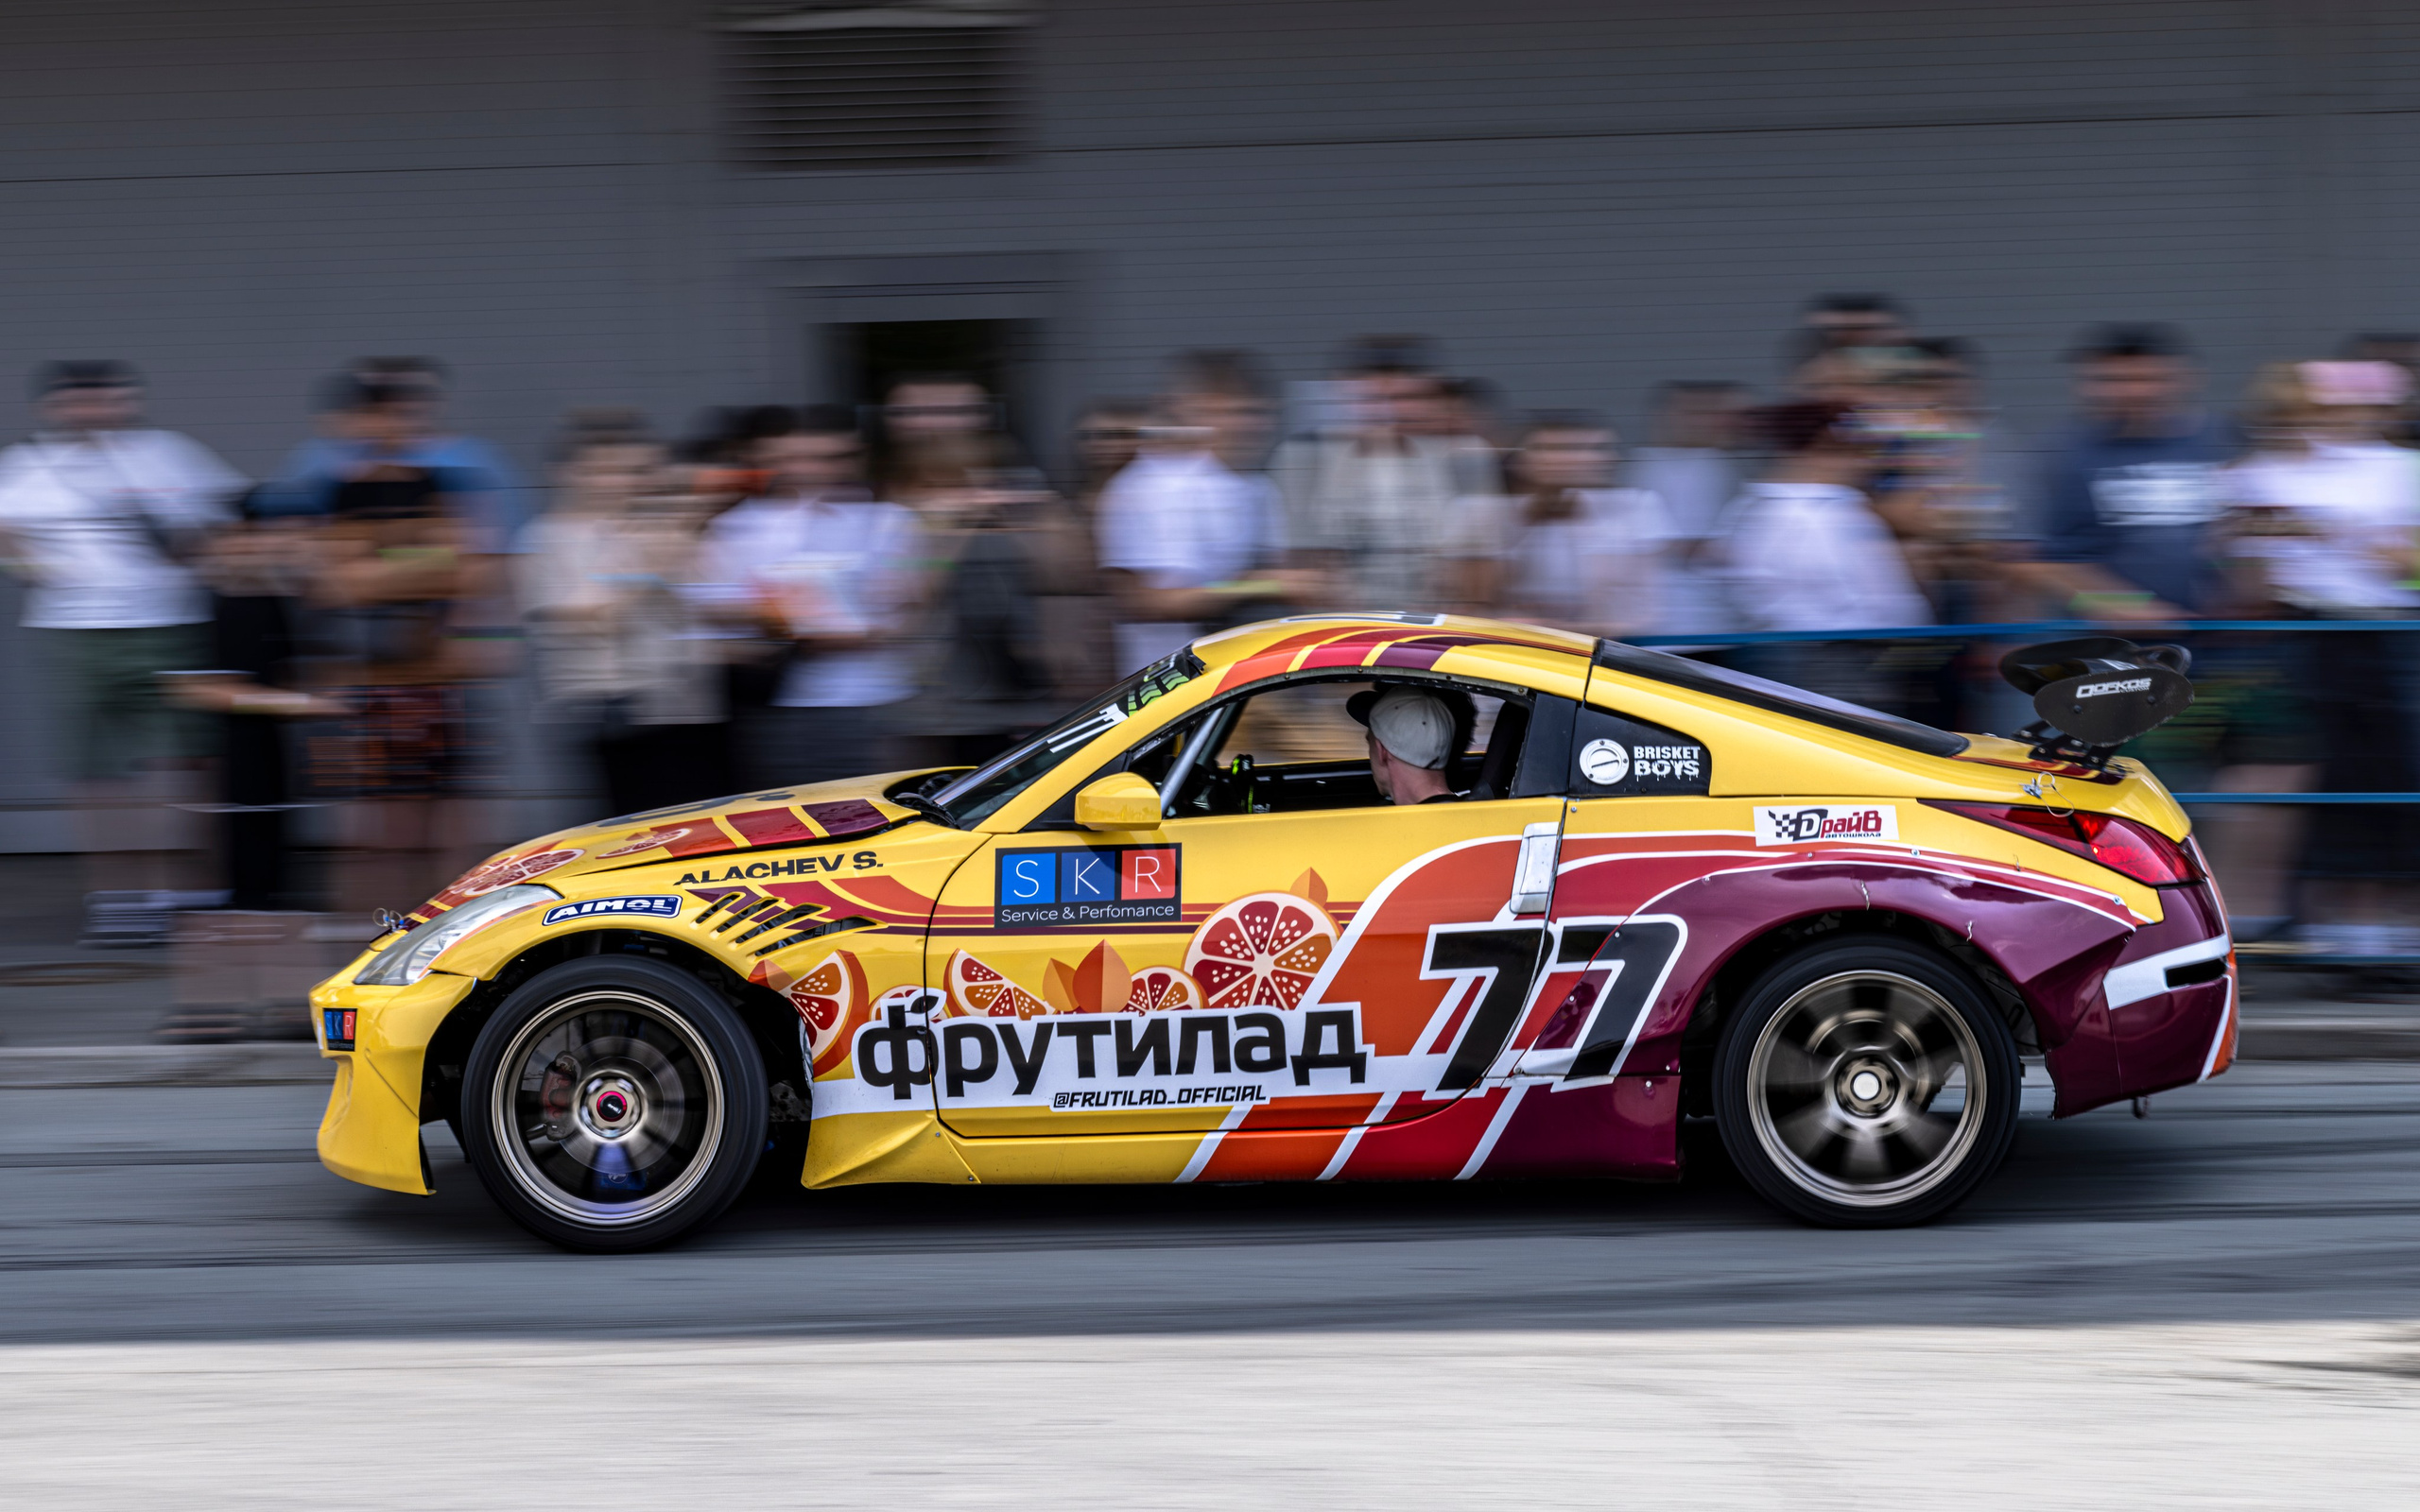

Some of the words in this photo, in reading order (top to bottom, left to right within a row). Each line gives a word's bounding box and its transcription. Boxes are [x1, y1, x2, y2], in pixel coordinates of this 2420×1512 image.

[1634, 746, 1701, 760] BRISKET
[1634, 760, 1701, 782] BOYS
[674, 853, 845, 886] ALACHEV
[853, 850, 884, 870] S.
[1013, 855, 1162, 898] SKR
[1001, 907, 1059, 923] Service
[1062, 906, 1076, 920] &
[1080, 903, 1174, 919] Perfomance
[1427, 918, 1681, 1091] 77
[1053, 1084, 1267, 1108] @FRUTILAD_OFFICIAL
